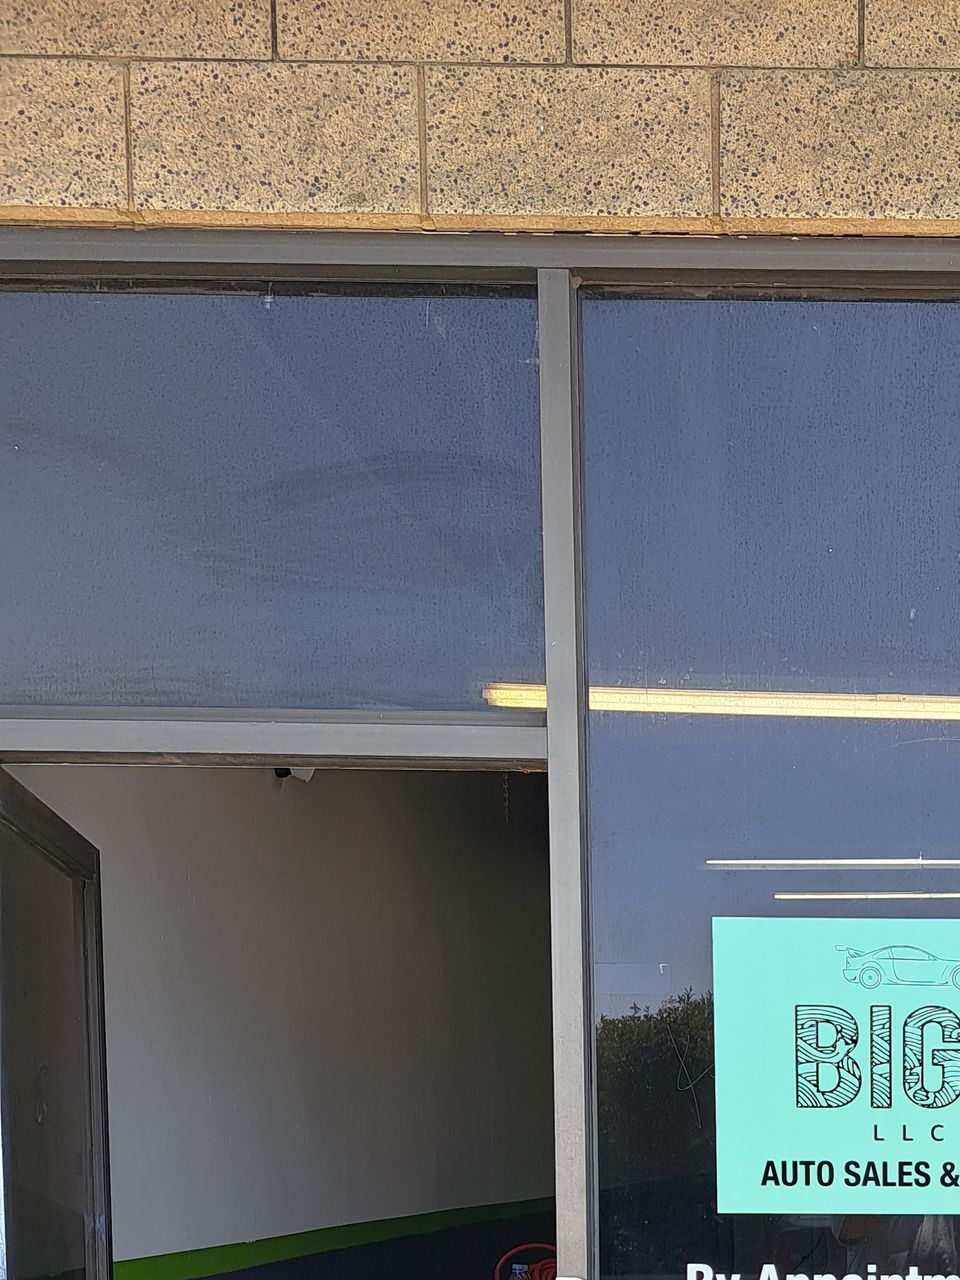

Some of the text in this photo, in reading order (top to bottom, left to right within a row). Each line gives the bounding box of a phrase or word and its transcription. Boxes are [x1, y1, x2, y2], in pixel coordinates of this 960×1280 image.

[761, 1161, 835, 1187] AUTO
[844, 1161, 931, 1188] SALES
[939, 1161, 960, 1188] &
